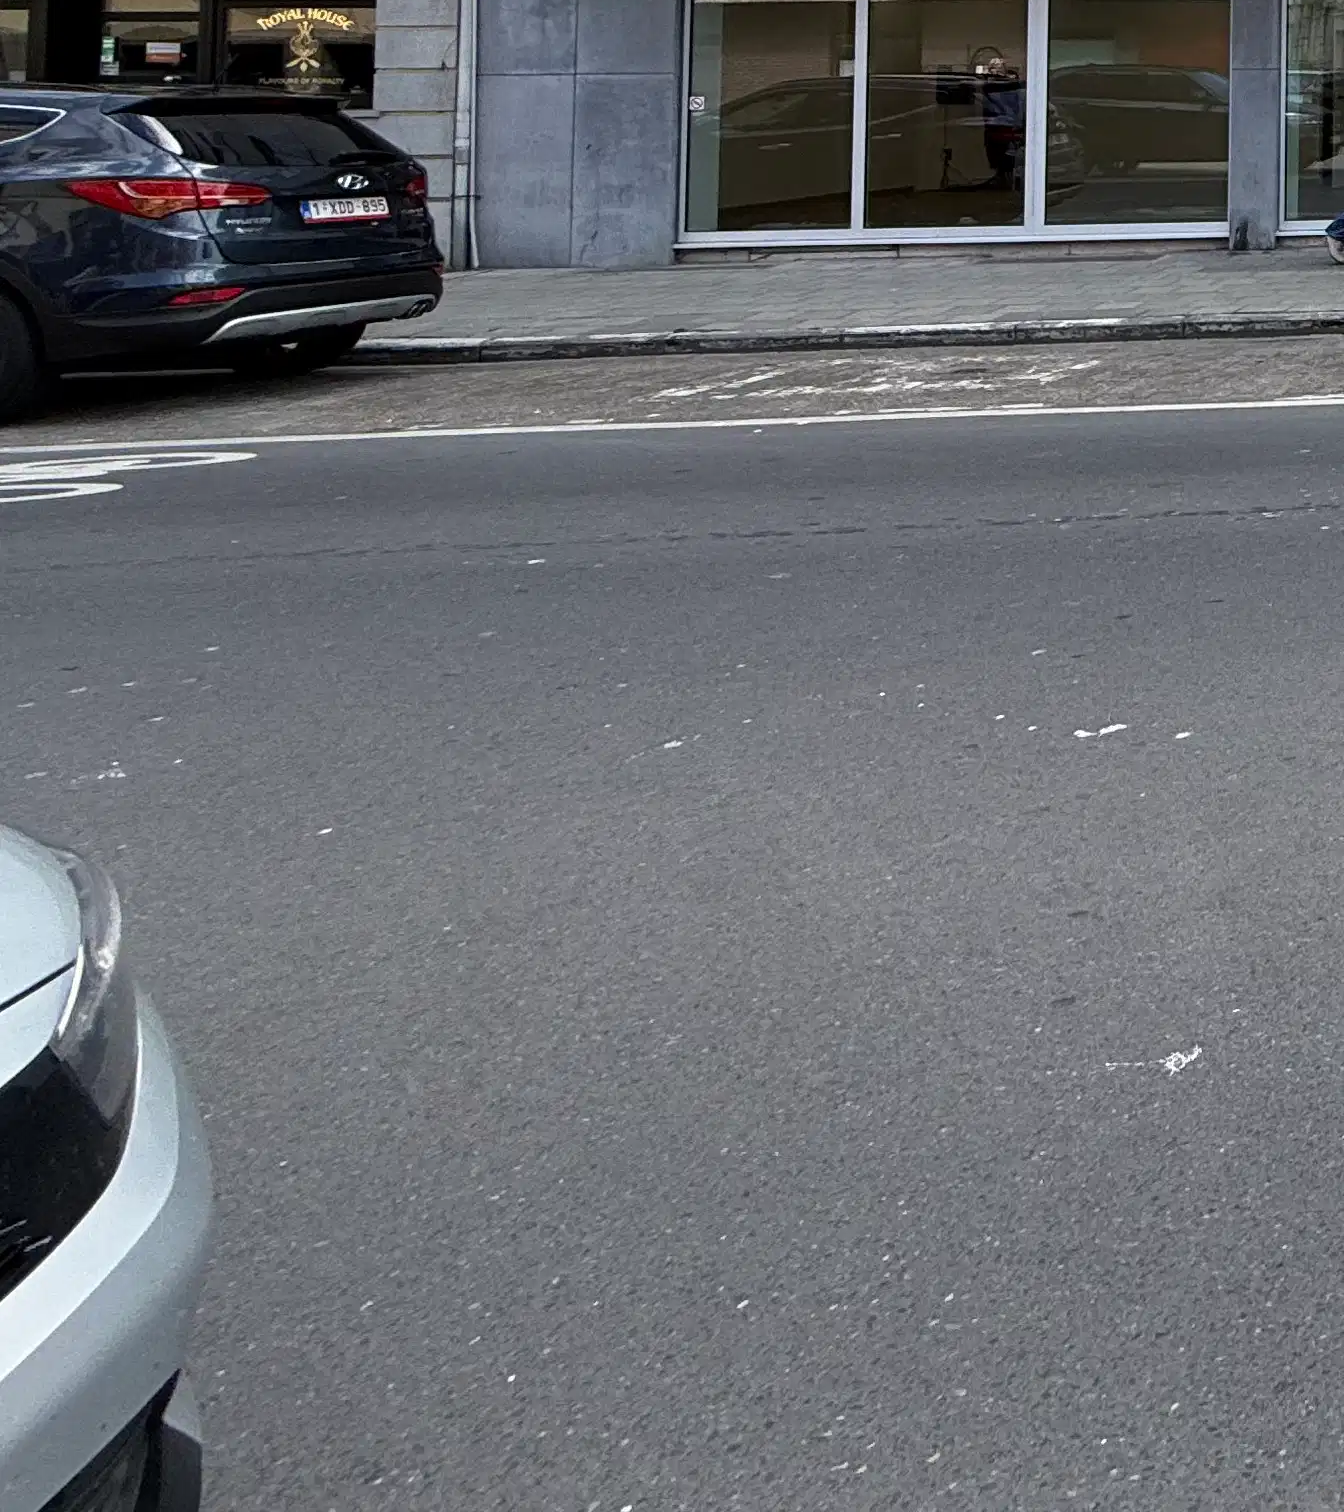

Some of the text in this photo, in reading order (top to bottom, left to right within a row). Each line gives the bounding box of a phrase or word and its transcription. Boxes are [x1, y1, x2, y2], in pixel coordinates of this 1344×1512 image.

[256, 8, 355, 31] ROYAL HOUSE
[312, 198, 387, 216] 1-XDD-895
